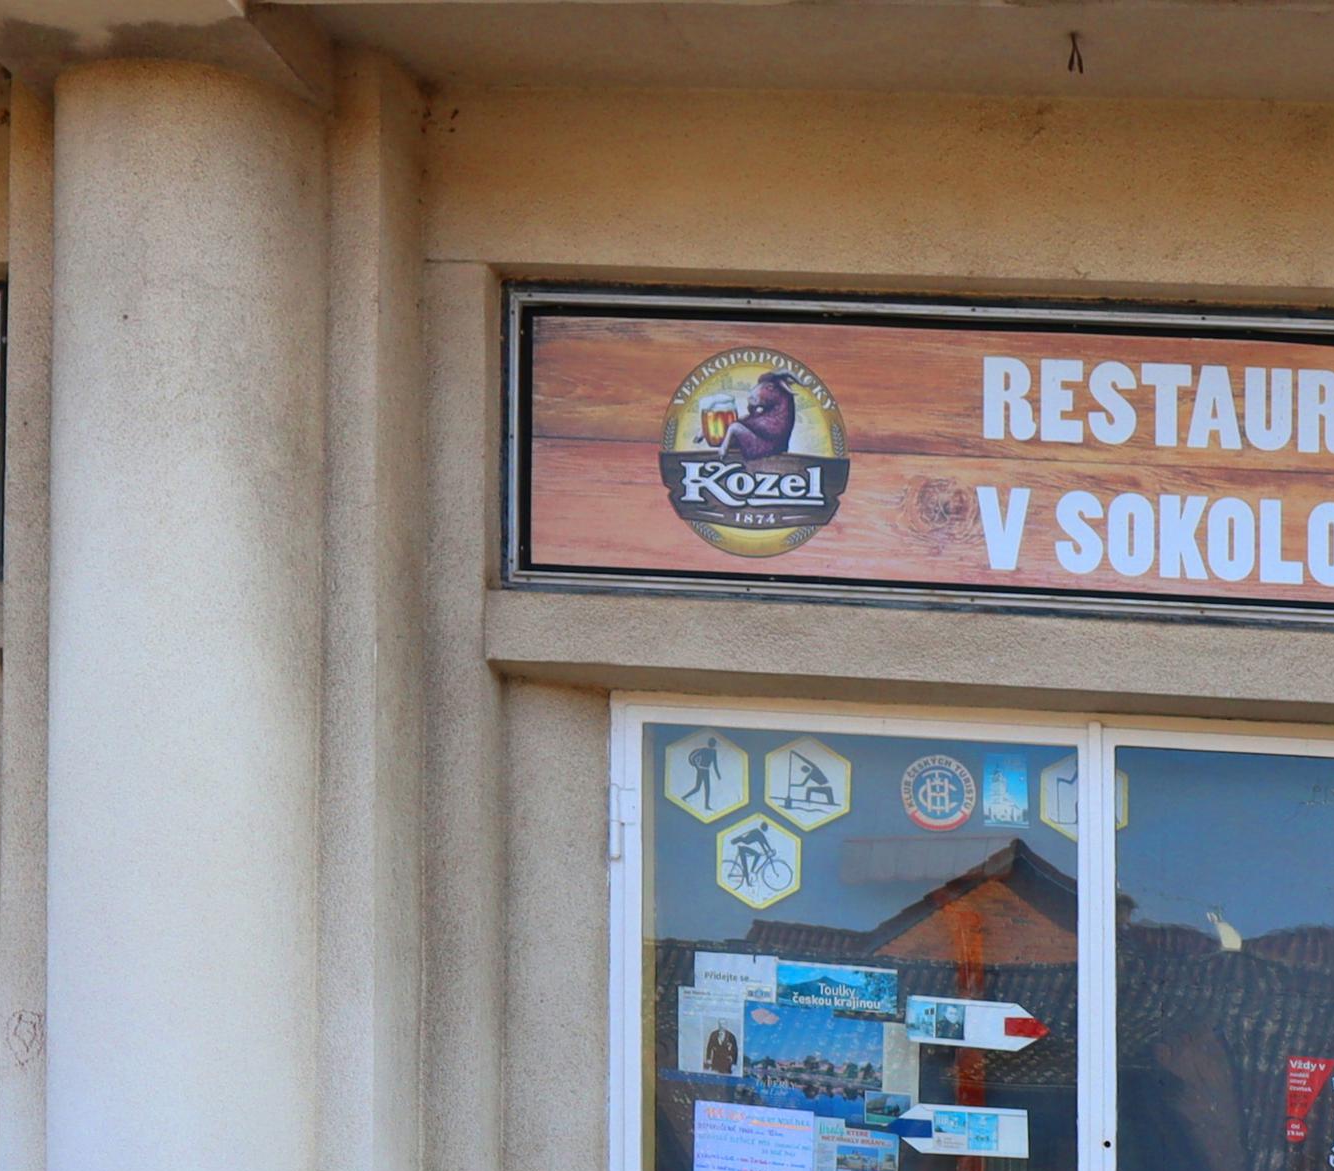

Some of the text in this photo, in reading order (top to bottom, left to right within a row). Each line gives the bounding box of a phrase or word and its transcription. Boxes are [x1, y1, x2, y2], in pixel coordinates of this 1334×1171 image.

[680, 461, 825, 506] Kozel
[733, 511, 777, 525] 1874
[976, 485, 1032, 572] V
[704, 970, 738, 985] Přidejte
[818, 982, 856, 999] Toulky
[792, 992, 832, 1007] českou
[833, 995, 881, 1011] krajinou
[1289, 1059, 1326, 1073] Vždy v
